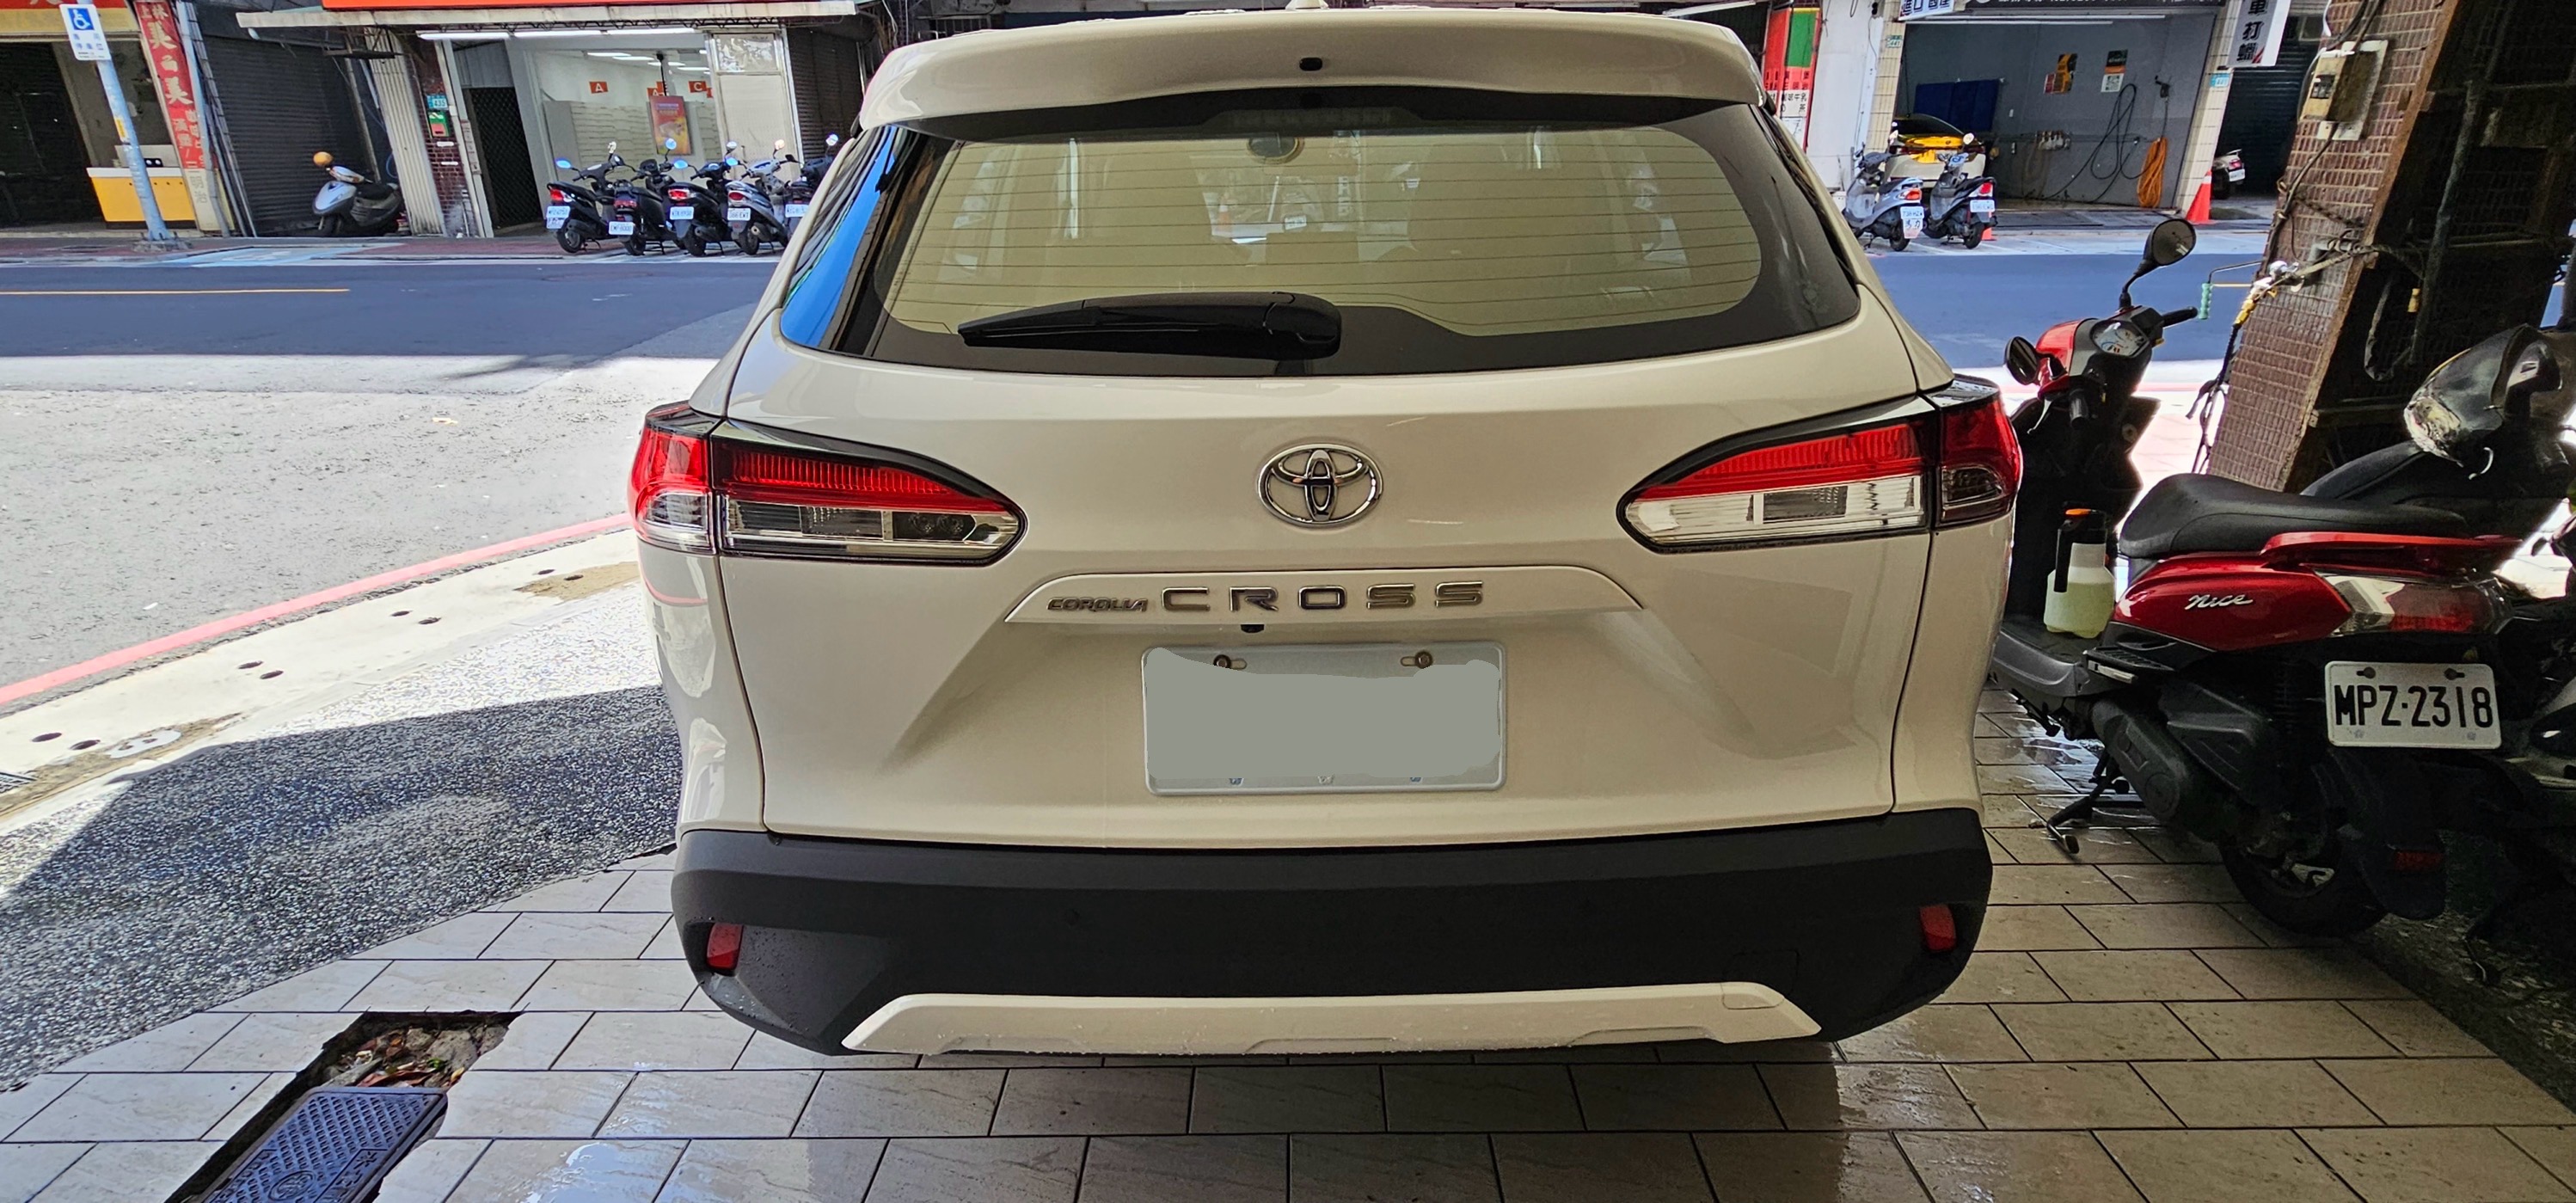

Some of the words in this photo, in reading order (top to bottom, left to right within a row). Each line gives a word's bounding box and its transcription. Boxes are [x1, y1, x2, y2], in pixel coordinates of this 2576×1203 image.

[595, 83, 604, 92] A
[693, 82, 702, 91] C
[1046, 596, 1149, 612] COROLLA
[1162, 580, 1482, 612] CROSS
